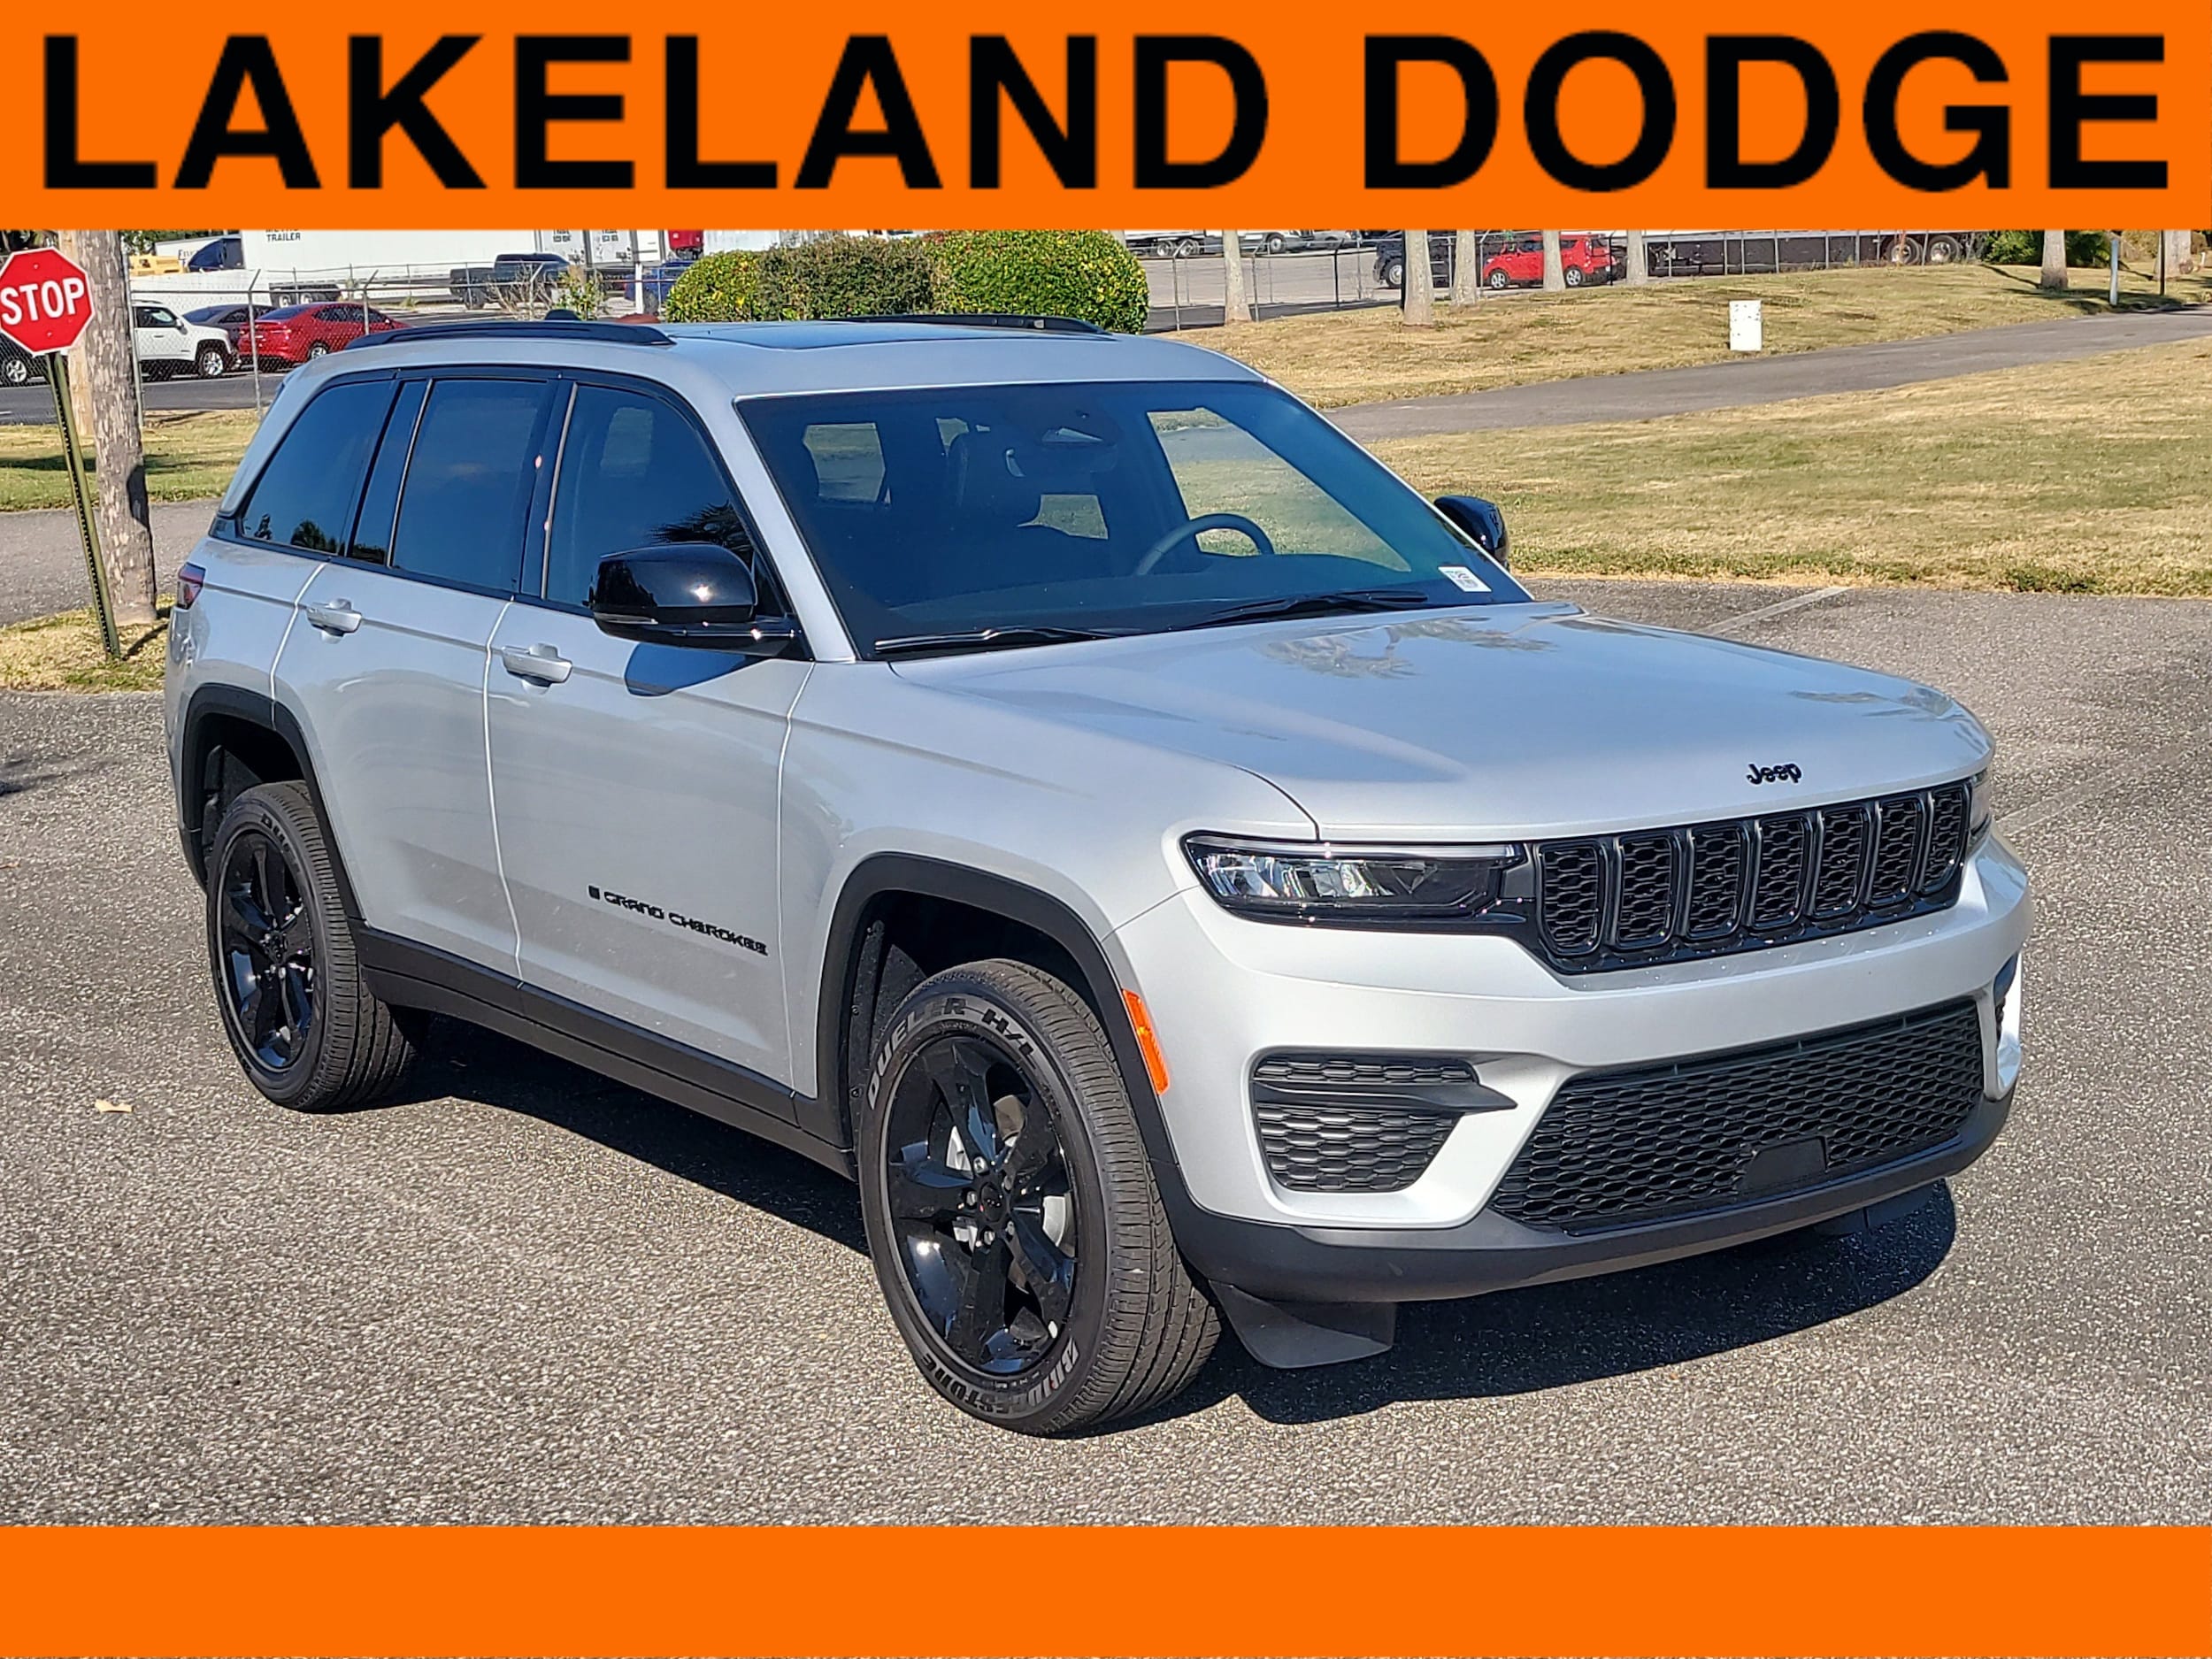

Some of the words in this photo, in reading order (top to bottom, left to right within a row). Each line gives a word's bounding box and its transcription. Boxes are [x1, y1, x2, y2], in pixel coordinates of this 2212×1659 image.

[266, 232, 301, 242] TRAILER
[0, 277, 85, 326] STOP
[1746, 763, 1802, 785] Jeep
[603, 890, 664, 920] GRAND
[668, 911, 768, 956] CHEROKEE
